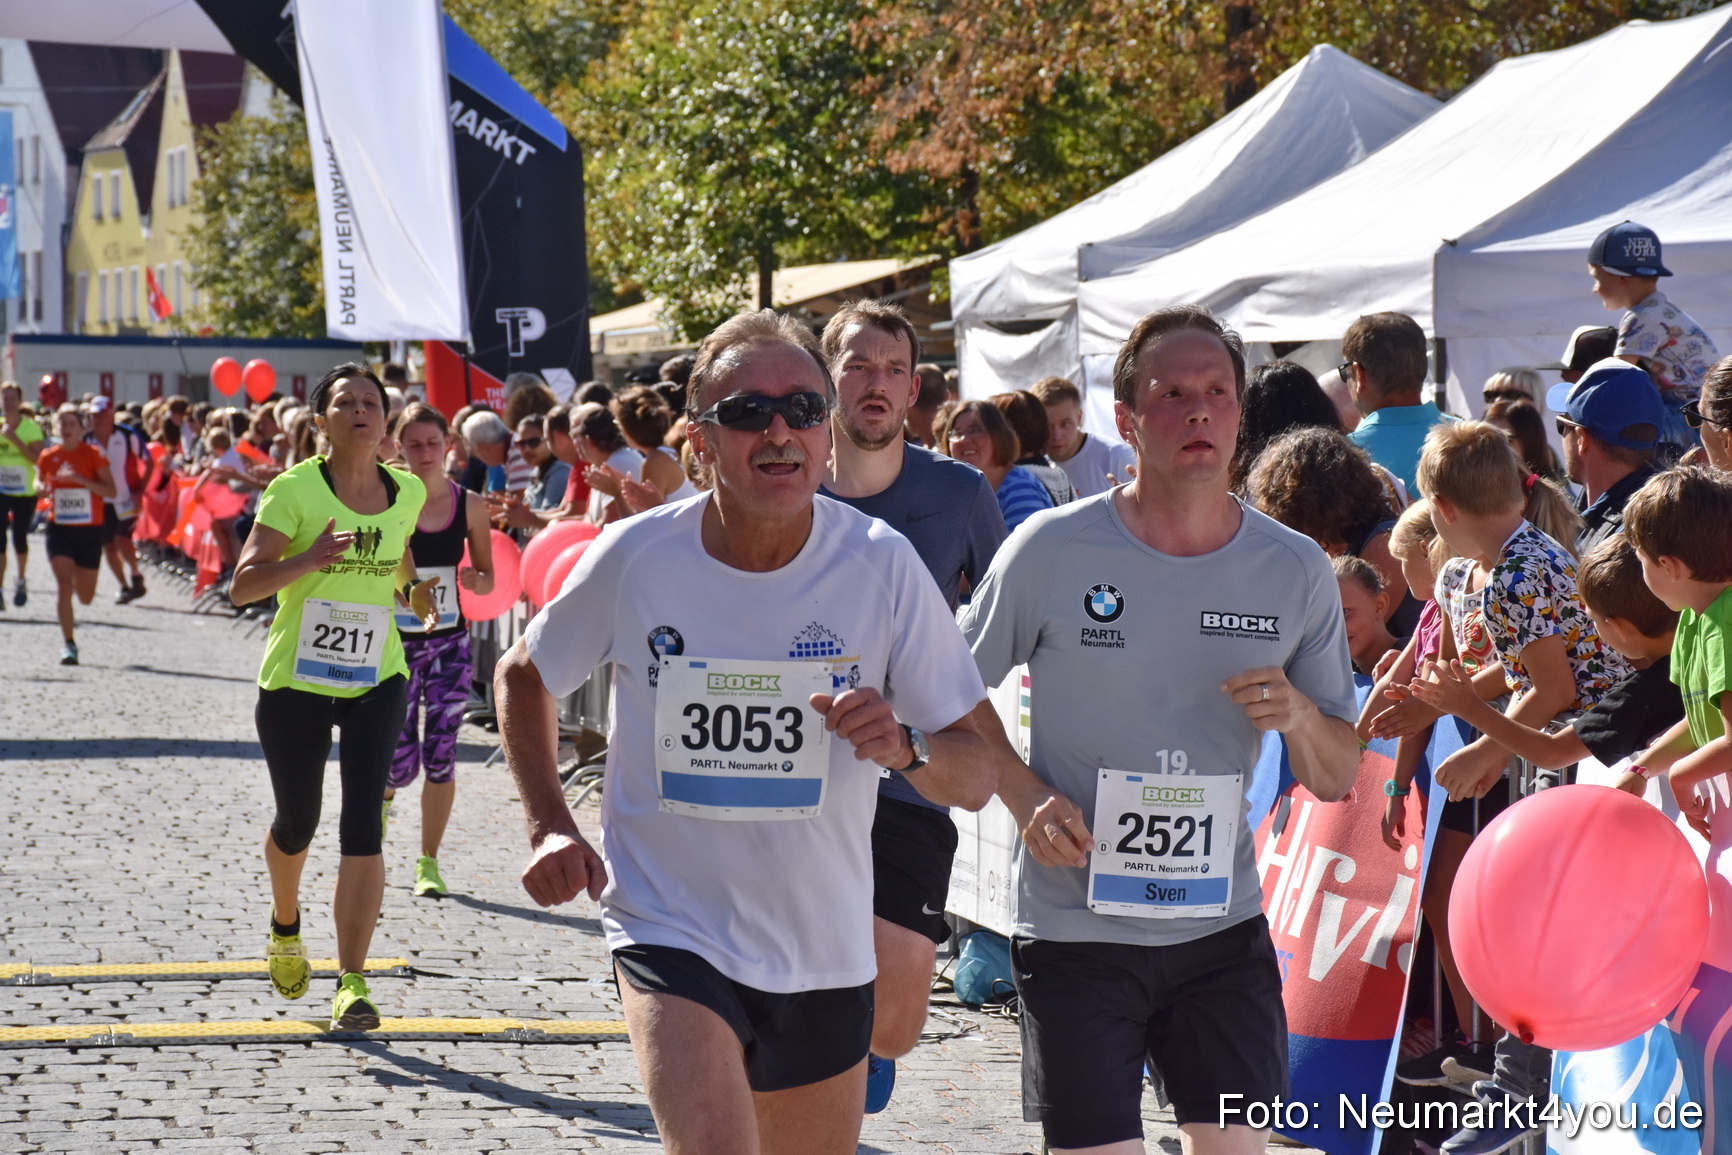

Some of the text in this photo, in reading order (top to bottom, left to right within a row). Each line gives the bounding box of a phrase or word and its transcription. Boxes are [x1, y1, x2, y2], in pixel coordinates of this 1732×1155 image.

[1628, 237, 1654, 248] NEW
[1624, 246, 1657, 257] YORK
[331, 609, 368, 622] BOCK
[1201, 611, 1280, 635] BOCK
[312, 623, 374, 654] 2211
[1081, 628, 1126, 640] PARTL
[1226, 630, 1234, 638] by
[1255, 634, 1280, 642] concepts
[1080, 638, 1125, 649] Neumarkt
[316, 652, 336, 661] PARTL
[327, 665, 353, 680] Ilona
[707, 673, 782, 692] BOCK
[706, 690, 729, 698] inspired
[681, 703, 804, 754] 3053
[664, 738, 671, 748] C
[690, 758, 778, 771] PARTL Neumarkt
[1155, 749, 1196, 776] 19.
[1142, 786, 1206, 803] BOCK
[1115, 812, 1214, 857] 2521
[1101, 844, 1107, 852] D
[1124, 861, 1198, 874] PARTL Neumarkt
[1145, 882, 1187, 902] Sven
